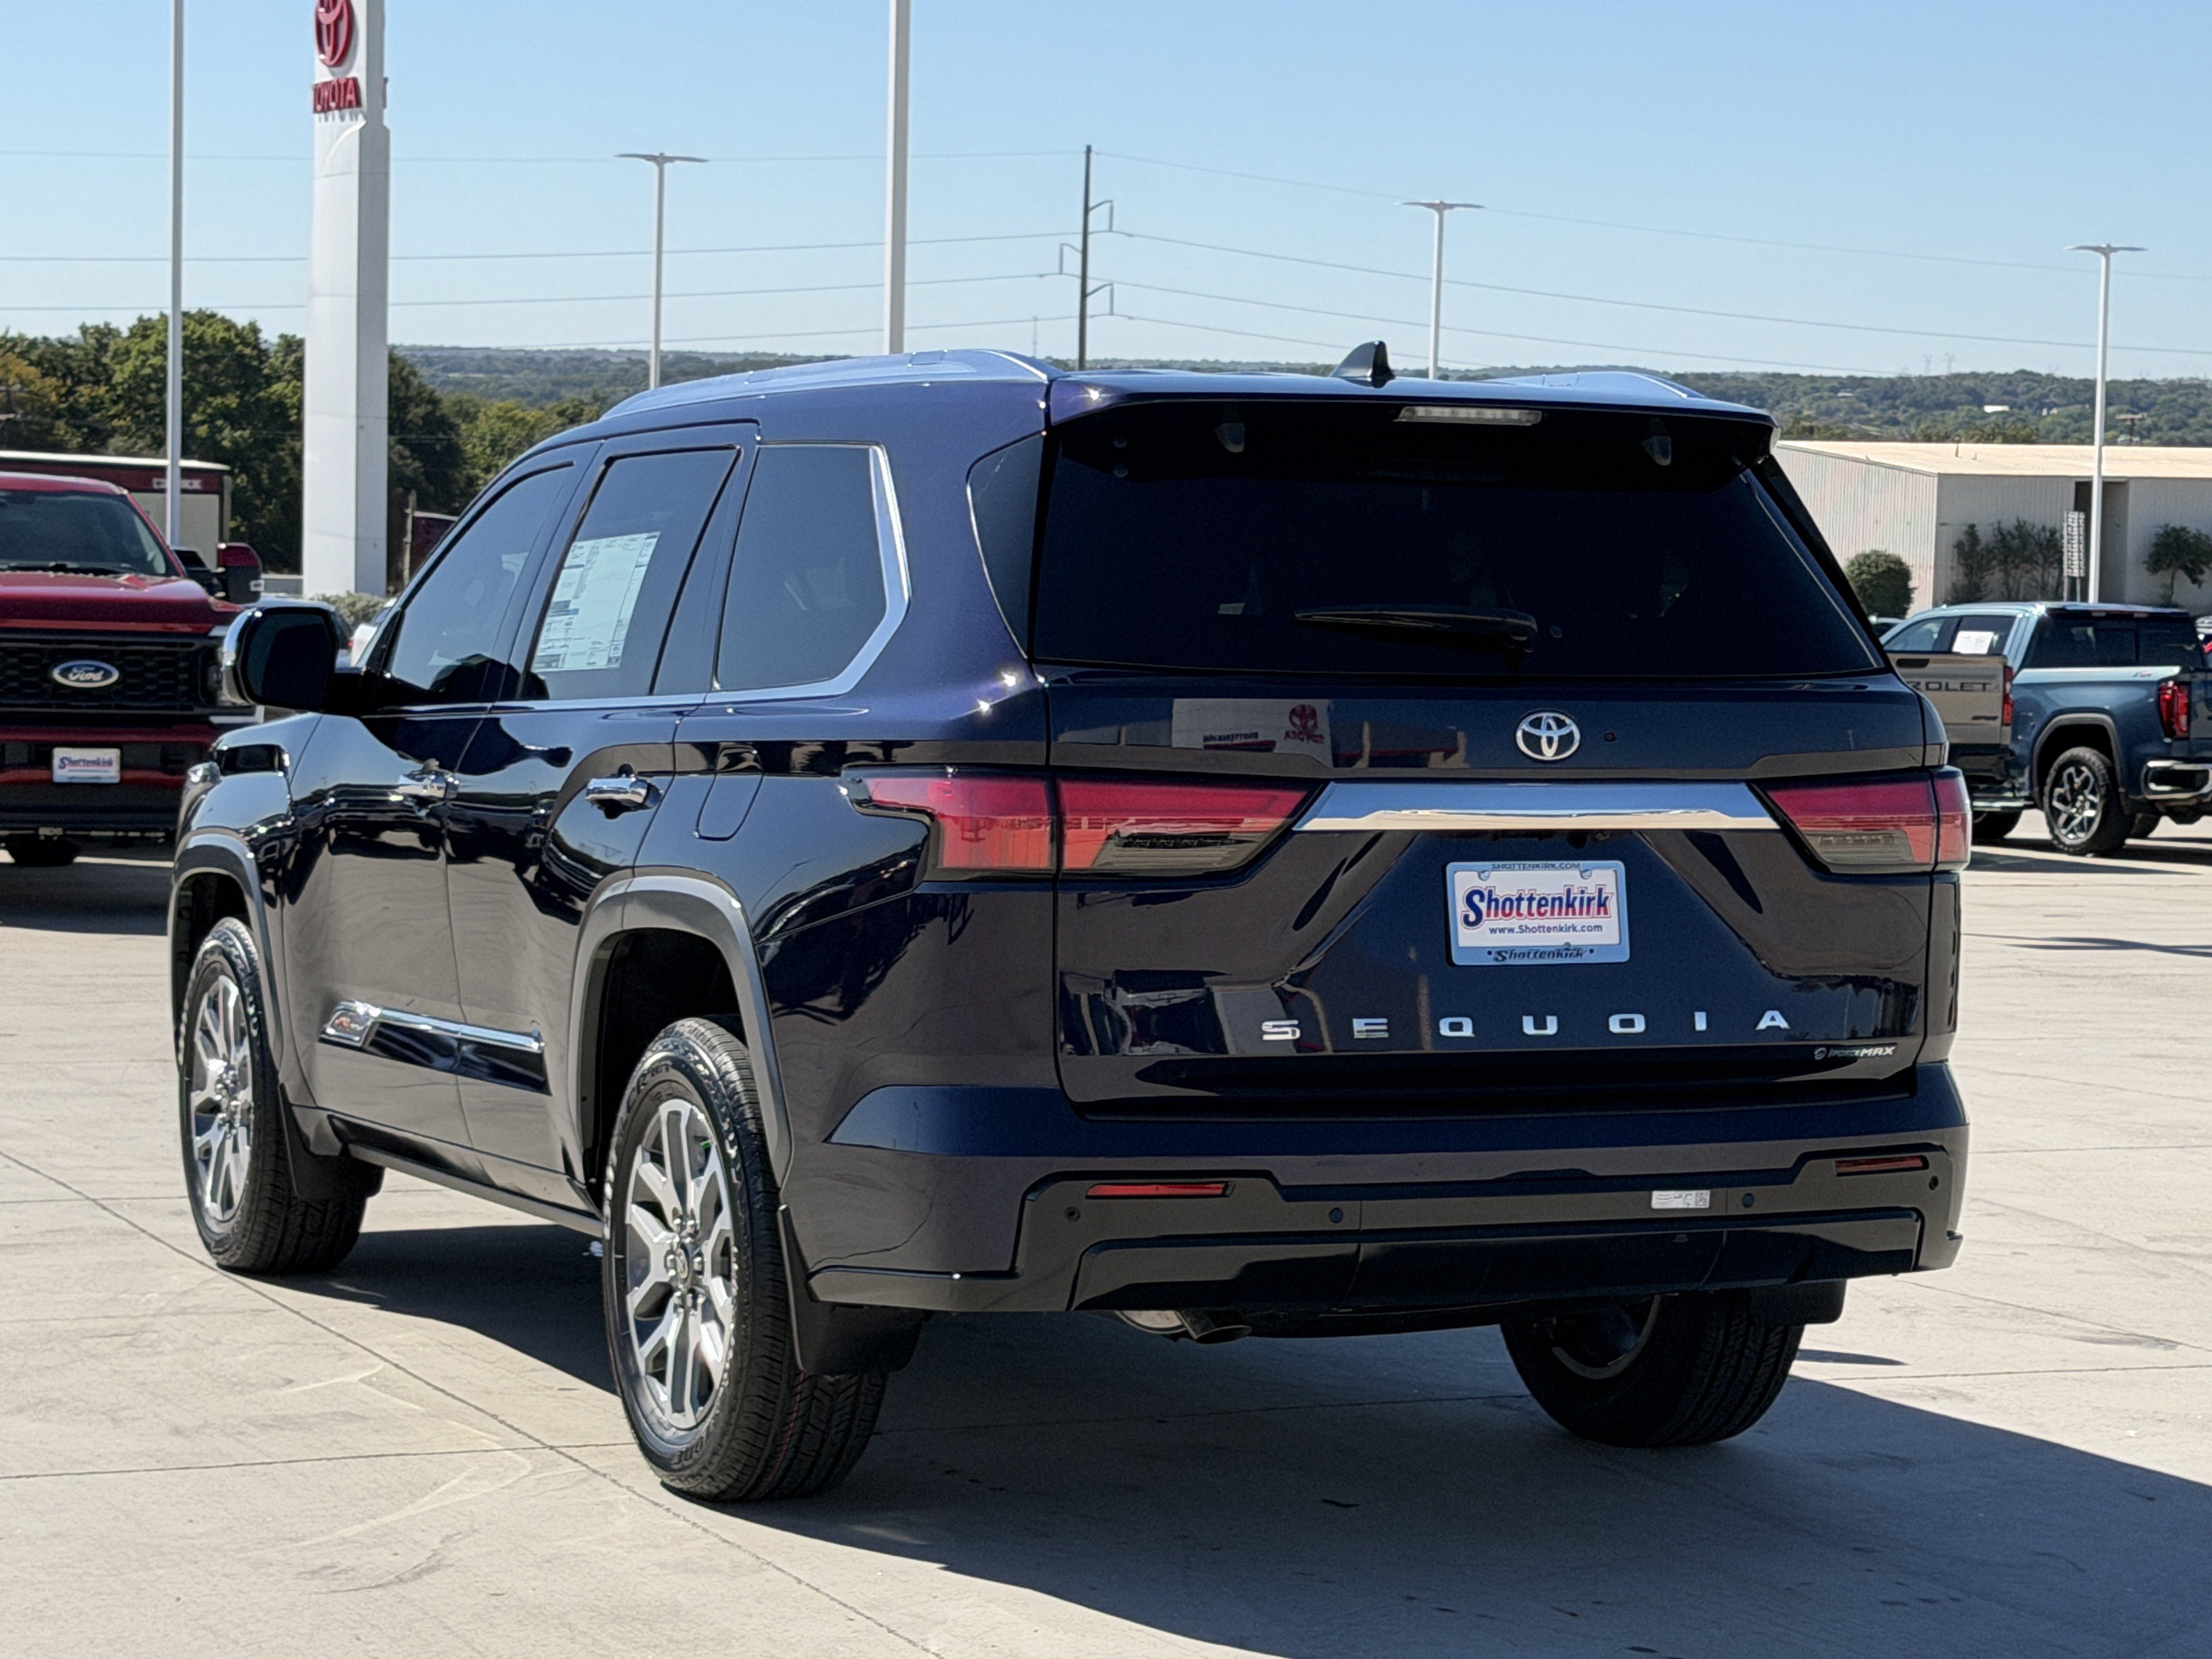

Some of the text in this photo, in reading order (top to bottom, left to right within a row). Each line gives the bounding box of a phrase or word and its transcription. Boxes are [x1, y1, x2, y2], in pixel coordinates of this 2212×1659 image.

[312, 78, 358, 111] TOYOTA
[68, 667, 104, 681] Ford
[1906, 681, 1991, 692] ROLET
[1462, 885, 1611, 928] Shottenkirk
[1488, 922, 1603, 935] www.Shottenkirk.com
[1493, 947, 1587, 962] Shottenkirk
[1261, 1010, 1790, 1041] SEQUOIA
